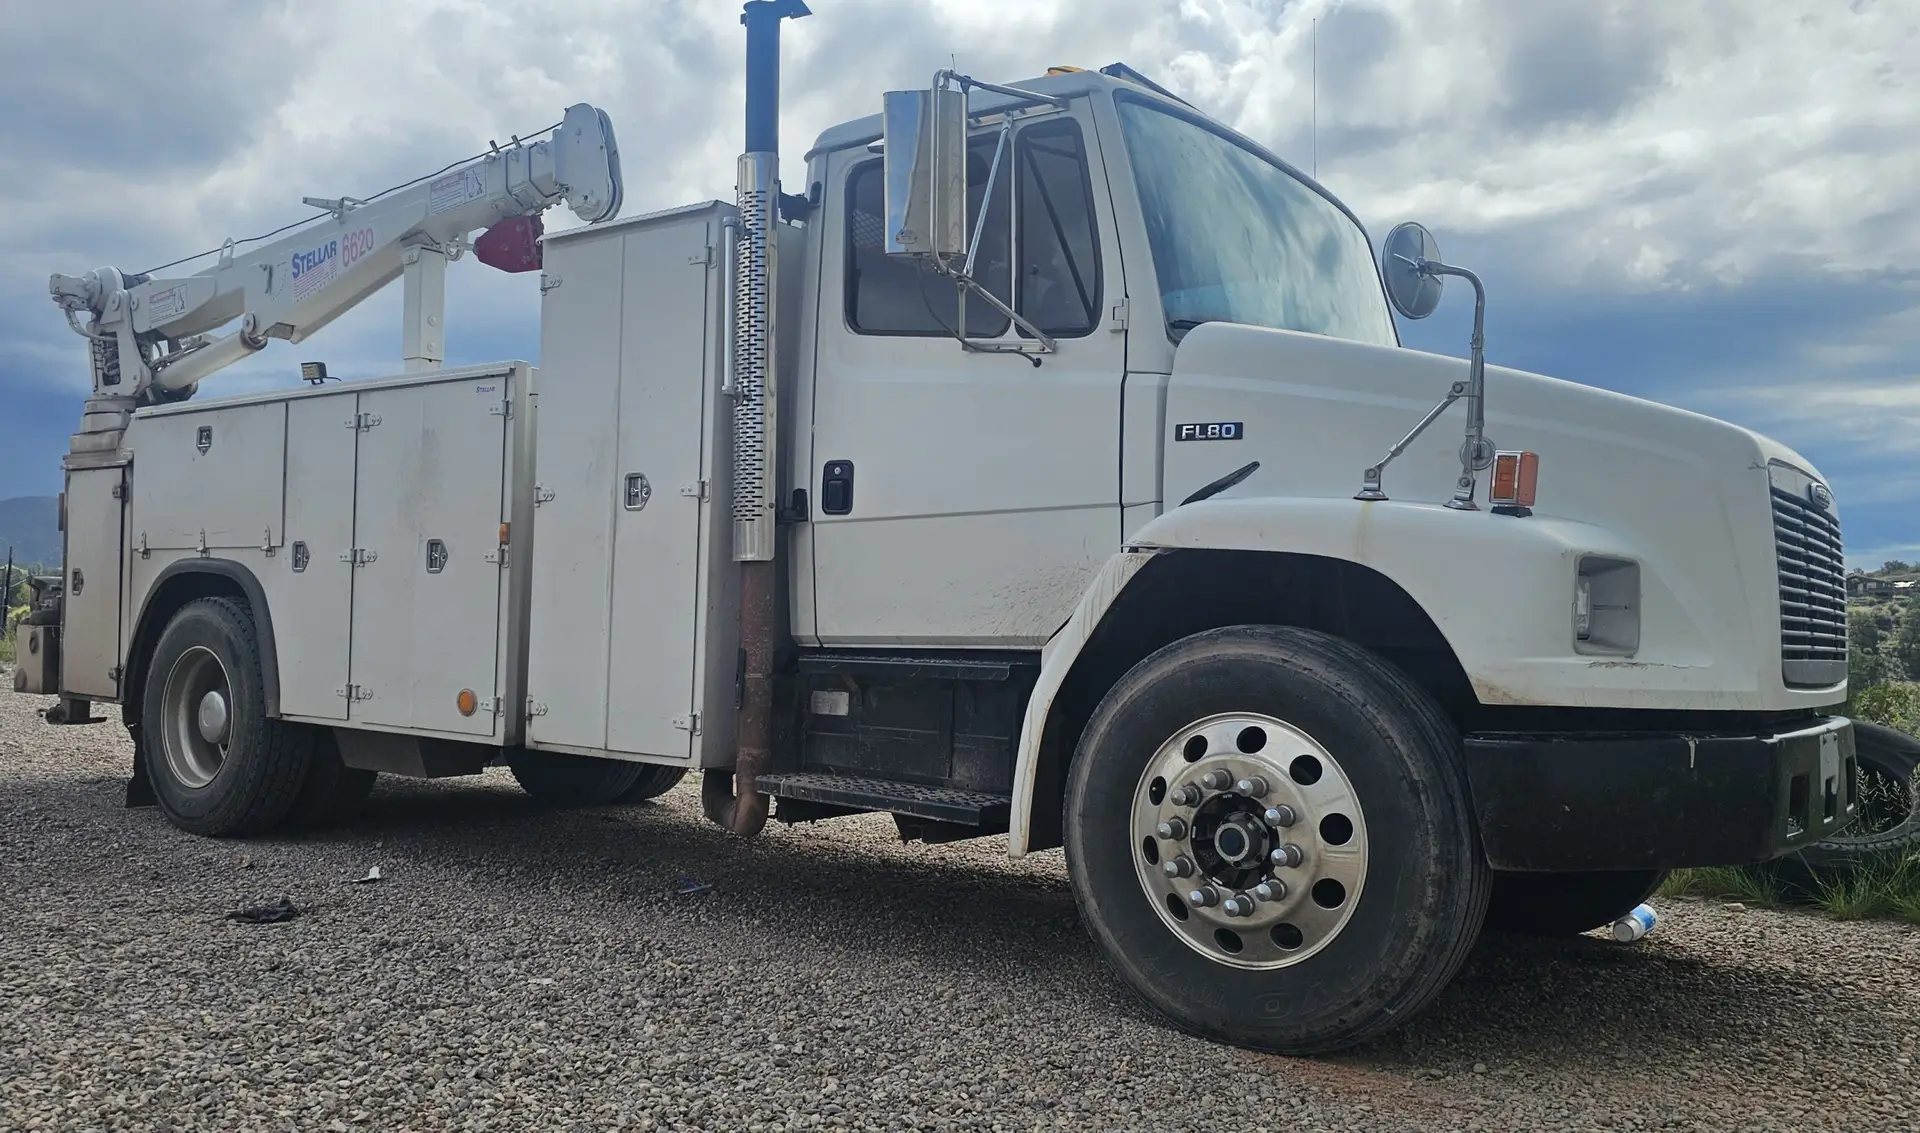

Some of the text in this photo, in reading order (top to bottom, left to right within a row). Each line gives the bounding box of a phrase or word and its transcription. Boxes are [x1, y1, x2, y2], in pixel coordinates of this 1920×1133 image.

[292, 227, 374, 279] STELLAR 6620
[1181, 424, 1236, 440] FL80
